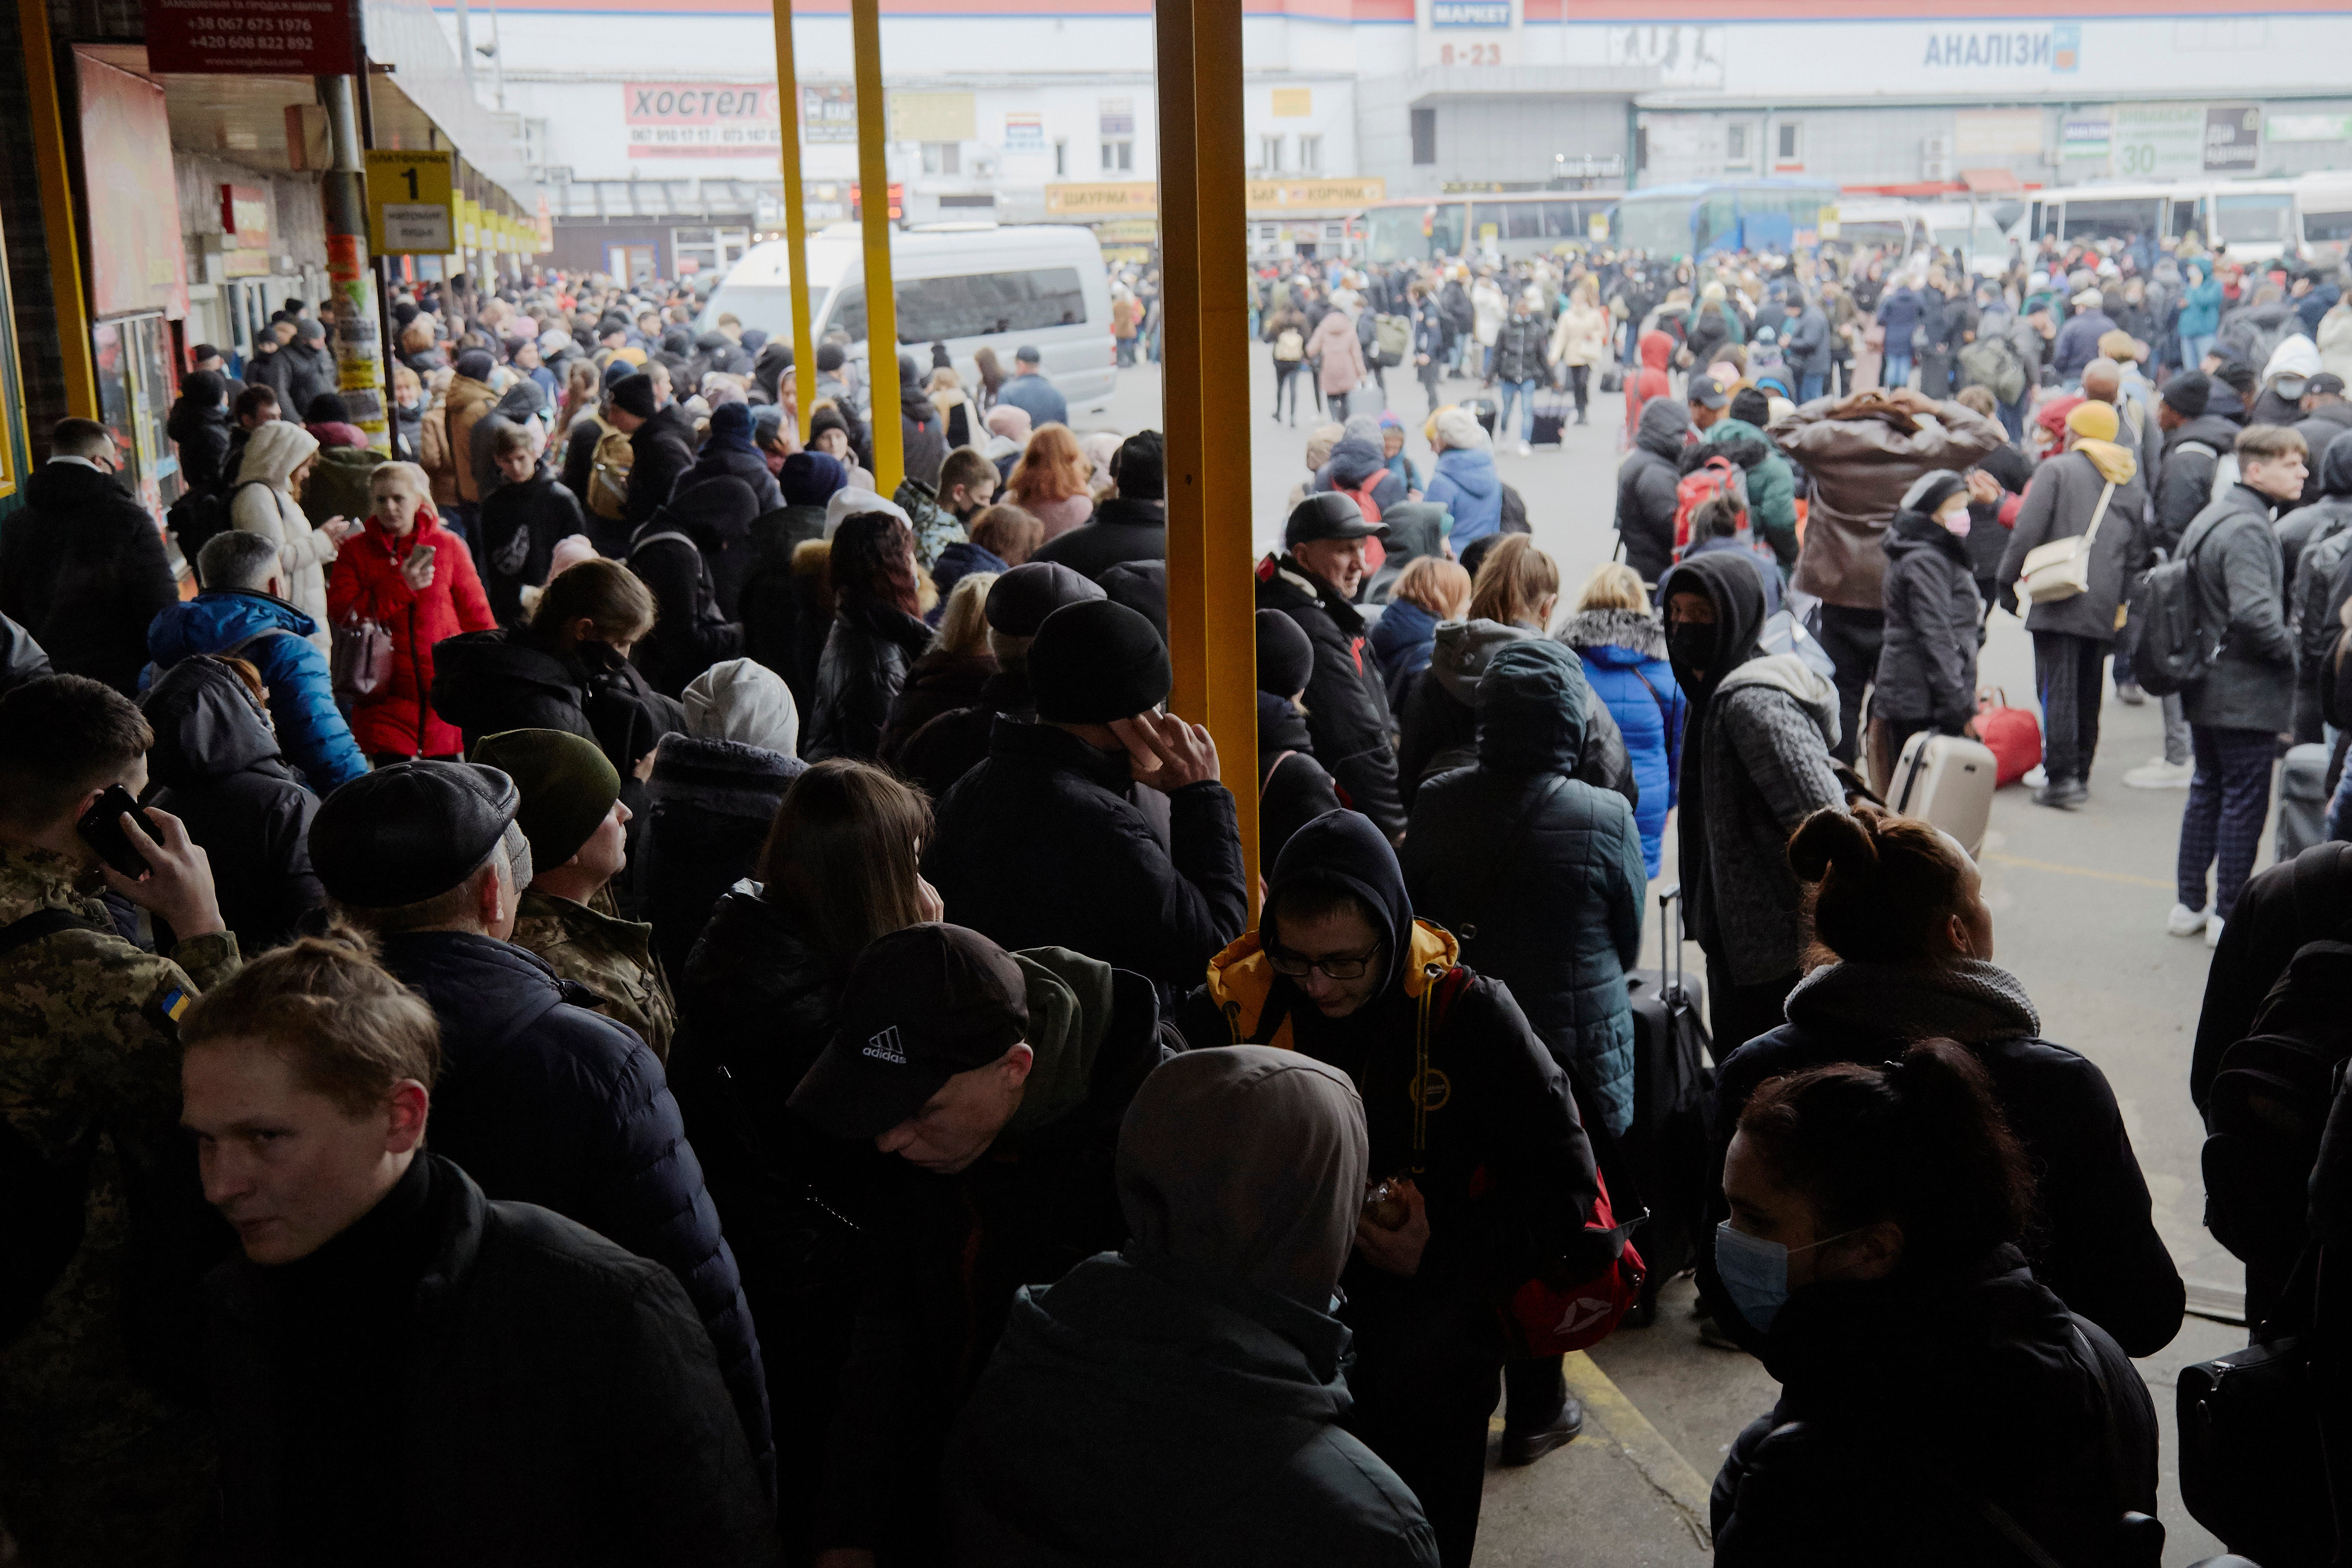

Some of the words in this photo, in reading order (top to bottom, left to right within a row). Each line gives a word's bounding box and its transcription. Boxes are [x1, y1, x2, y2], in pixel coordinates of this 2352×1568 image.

[1435, 5, 1507, 22] МАРКЕТ
[187, 16, 214, 29] +38
[216, 17, 243, 30] 067
[246, 17, 273, 30] 675
[277, 18, 312, 31] 1976
[189, 35, 225, 48] +420
[257, 36, 284, 49] 822
[286, 37, 313, 50] 892
[1924, 33, 2051, 67] АНАЛІЗИ
[2122, 144, 2155, 173] 30
[400, 167, 419, 201] 1
[862, 1047, 906, 1064] adidas
